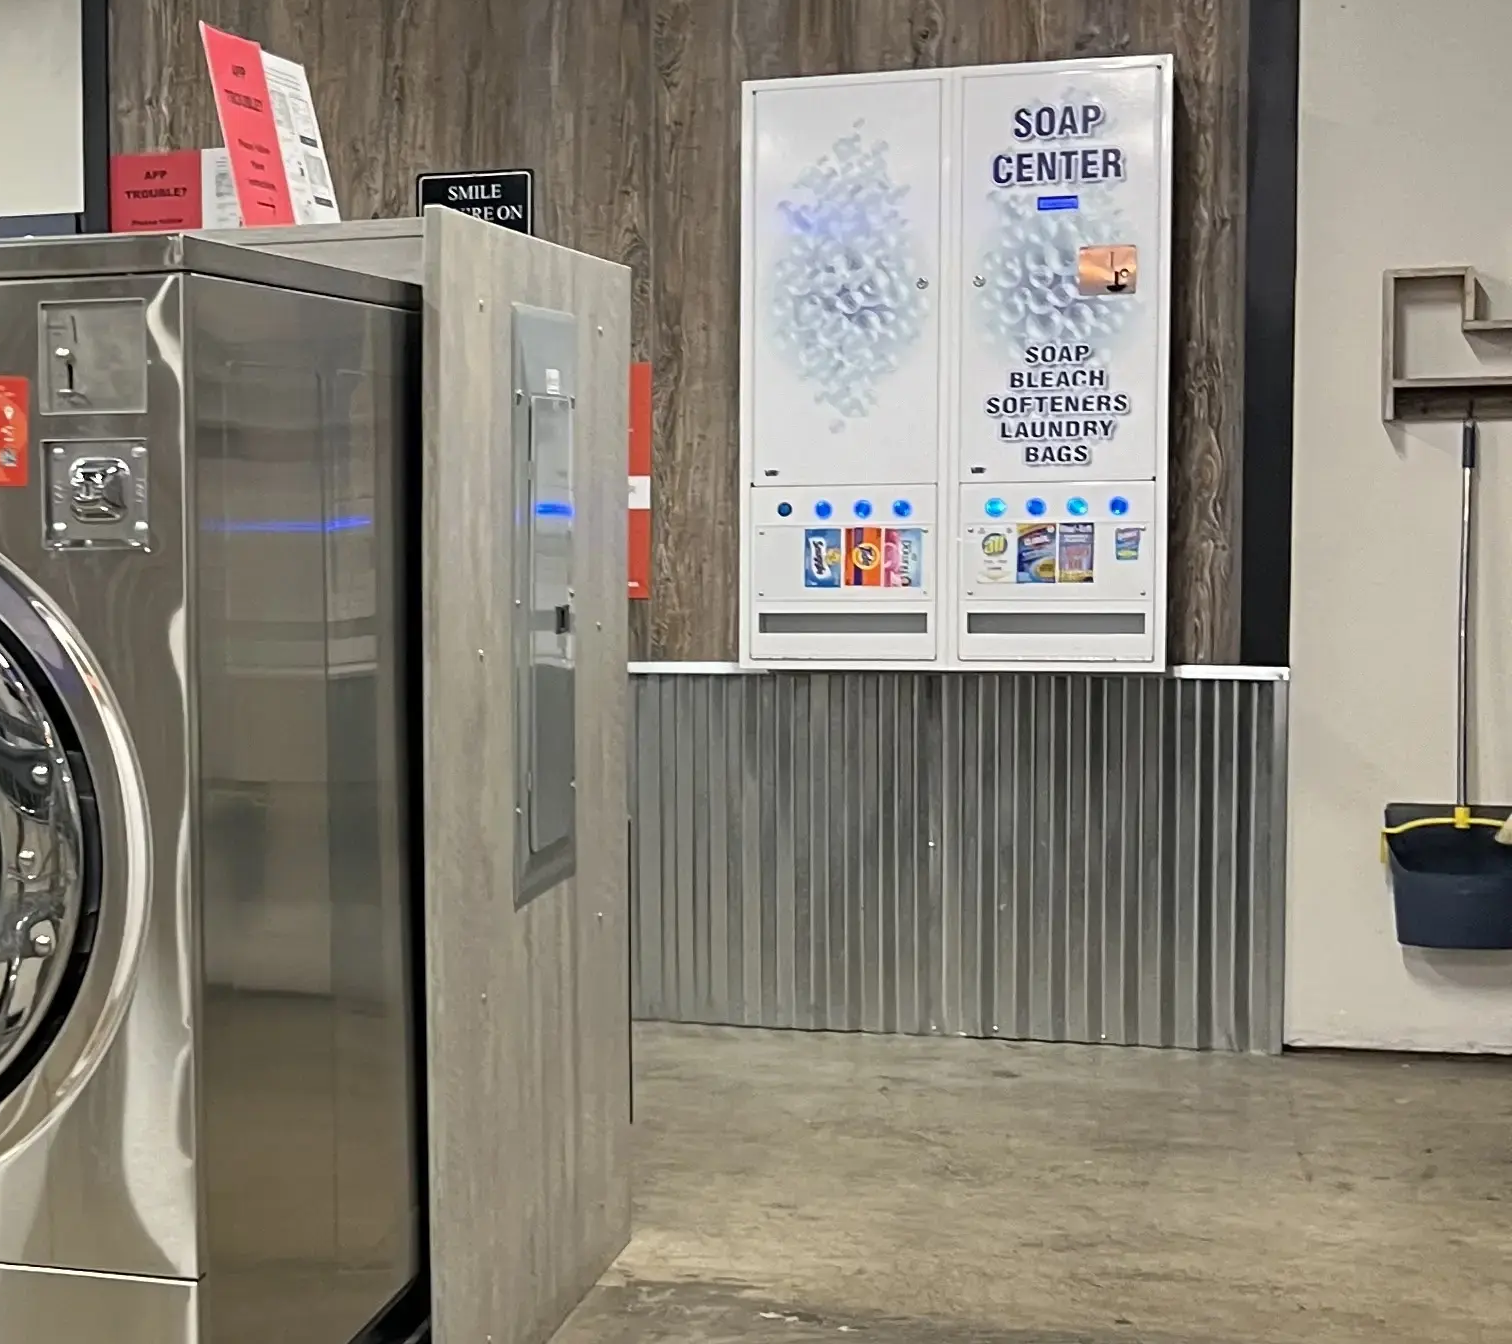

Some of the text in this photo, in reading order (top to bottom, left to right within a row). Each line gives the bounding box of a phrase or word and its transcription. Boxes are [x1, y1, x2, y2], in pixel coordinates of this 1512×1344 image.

[1013, 104, 1104, 138] SOAP
[144, 170, 167, 180] APP
[992, 149, 1124, 186] CENTER
[124, 187, 187, 200] TROUBLE?
[448, 184, 502, 201] SMILE
[497, 205, 523, 220] ON
[1025, 345, 1089, 364] SOAP
[1010, 369, 1105, 390] BLEACH
[986, 394, 1127, 415] SOFTENERS
[1000, 420, 1114, 441] LAUNDRY
[1025, 444, 1088, 464] BAGS
[983, 535, 1005, 556] all
